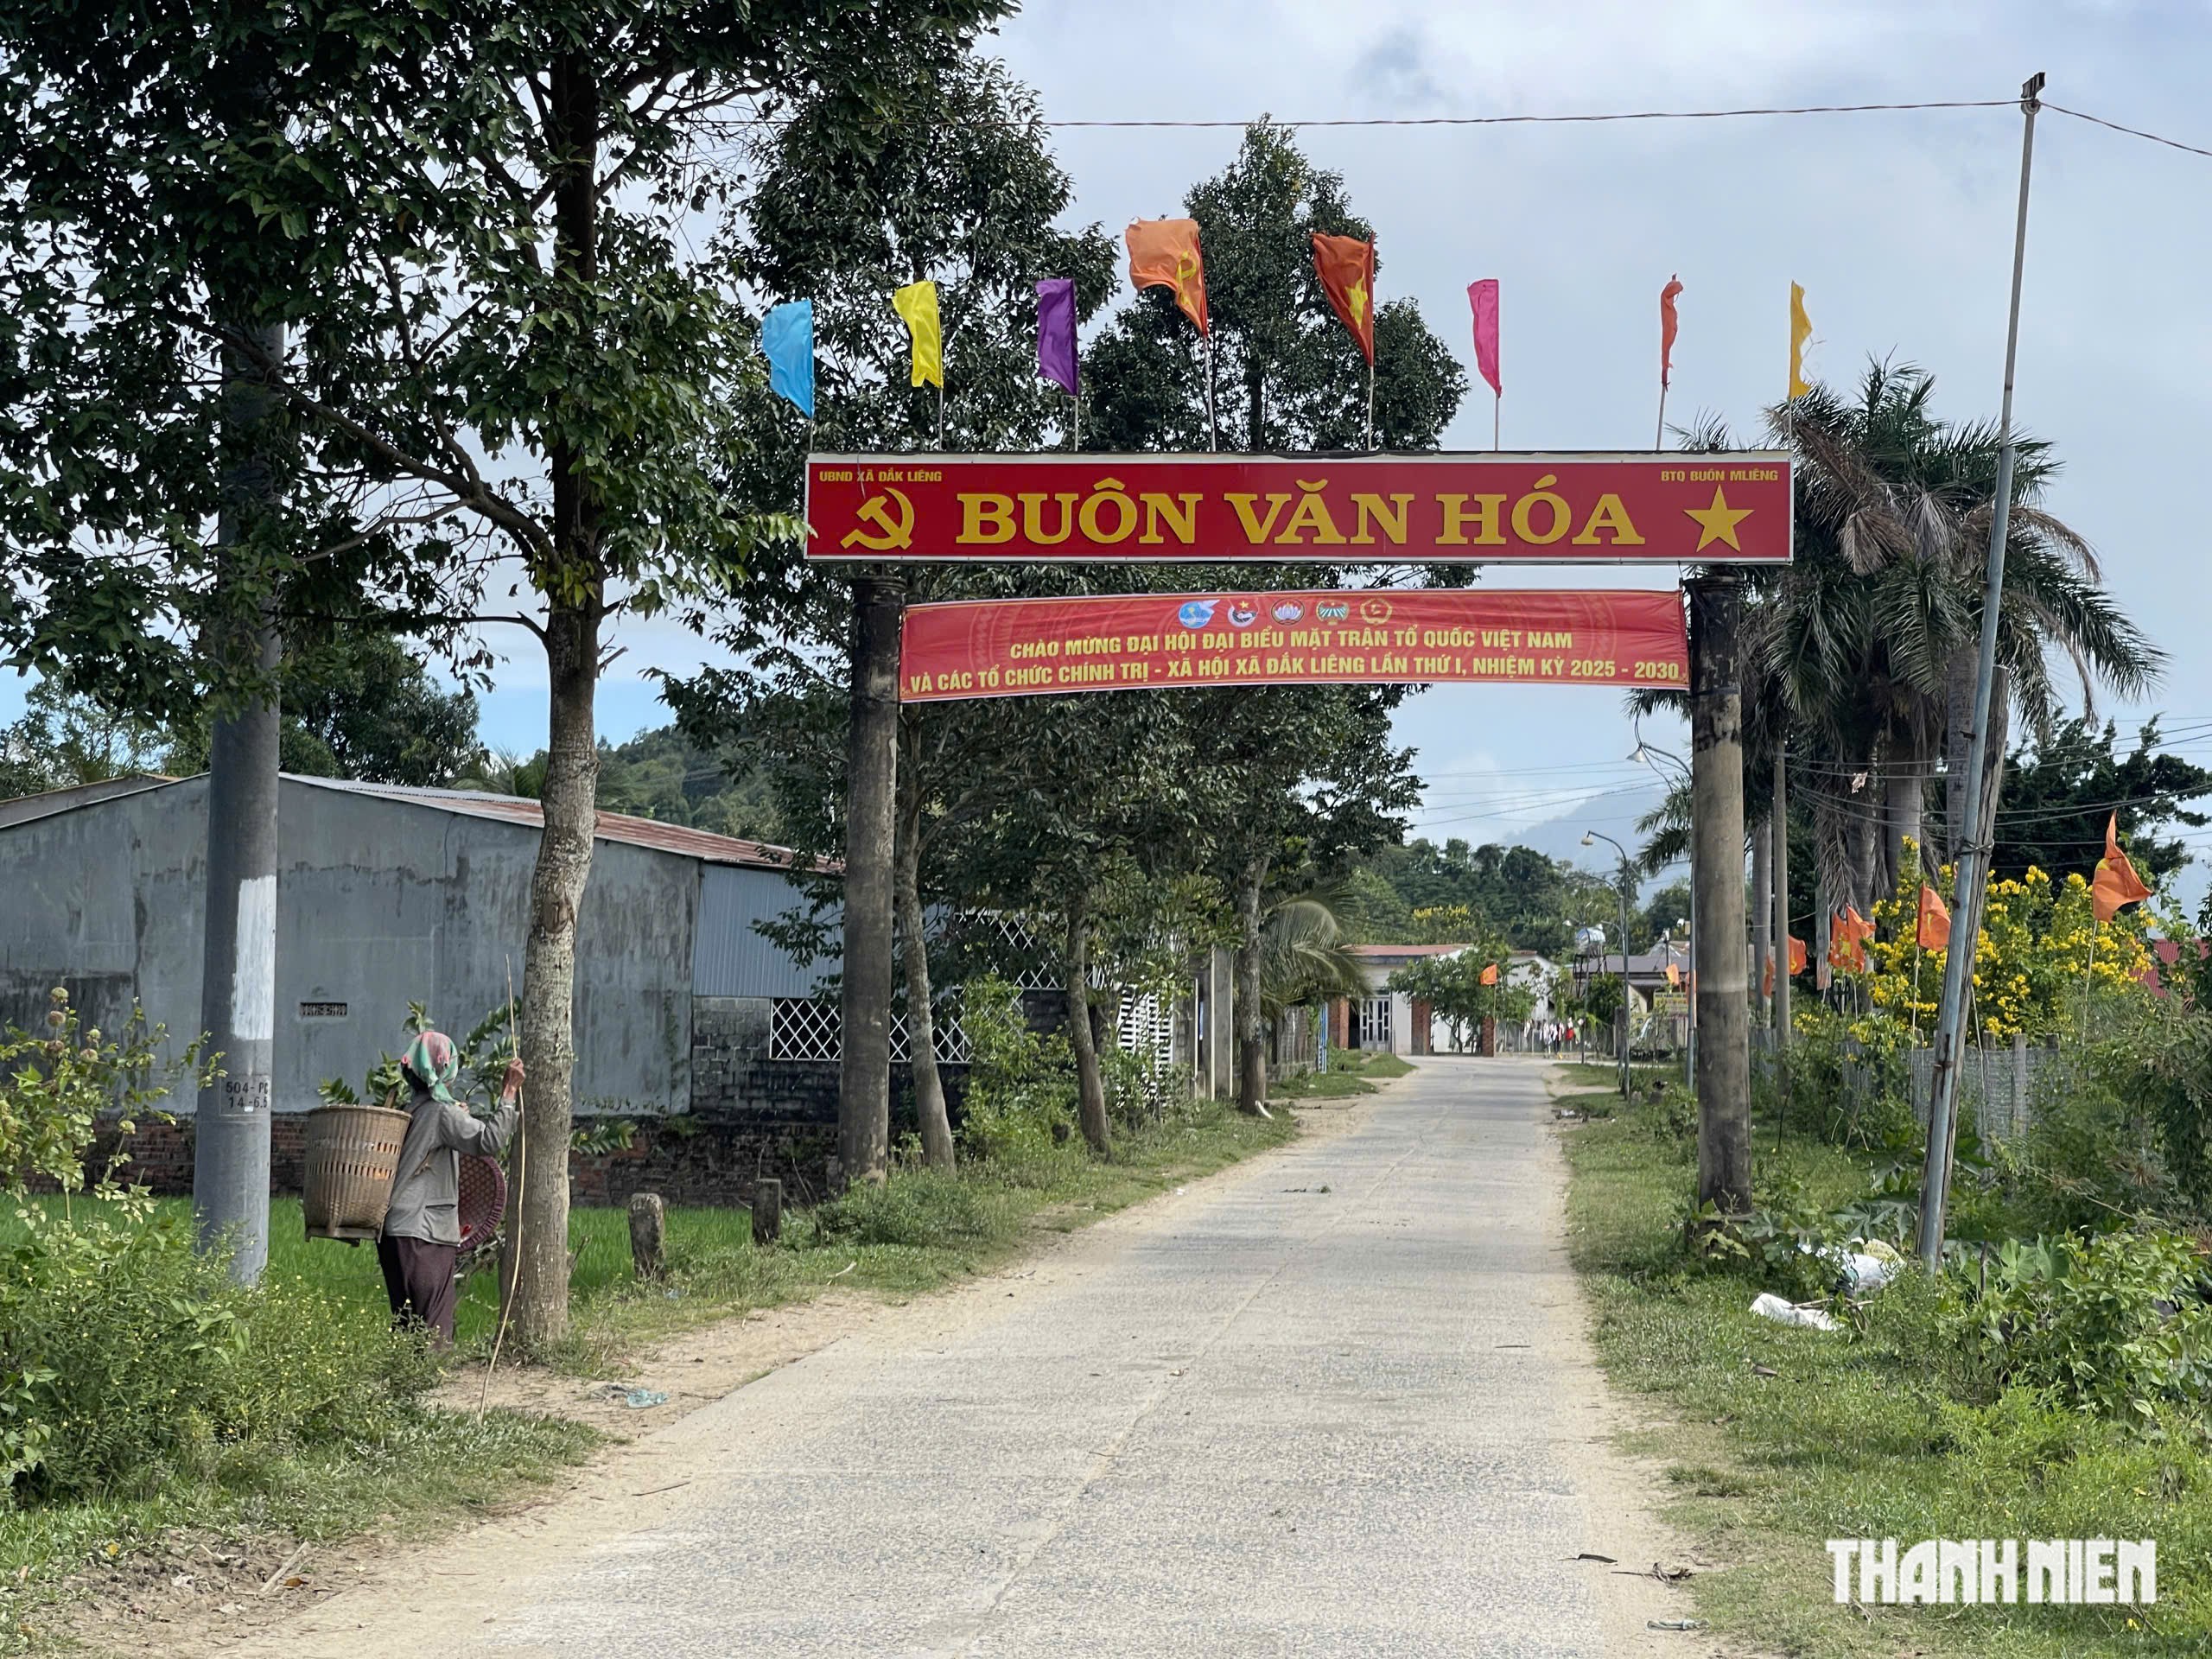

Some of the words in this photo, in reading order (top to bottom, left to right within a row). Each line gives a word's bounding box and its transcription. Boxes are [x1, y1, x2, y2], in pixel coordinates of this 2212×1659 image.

[819, 471, 853, 482] UBND
[856, 468, 874, 482] XÃ
[907, 469, 942, 482] LIÊNG
[1689, 468, 1726, 481] BUÔN
[1729, 468, 1779, 481] MLIÊNG
[956, 477, 1203, 544] BUÔN
[1224, 479, 1415, 545] VĂN
[1435, 474, 1645, 545] HÓA
[1010, 639, 1059, 659] CHÀO
[1065, 635, 1121, 656] MỪNG
[1127, 635, 1159, 655] ĐẠI
[1165, 631, 1197, 654] HỘI
[1202, 633, 1234, 652] ĐẠI
[1241, 626, 1284, 648] BIỂU
[1290, 628, 1332, 651] MẶT
[1338, 627, 1389, 651] TRẬN
[1394, 624, 1418, 647] TỔ
[1424, 626, 1475, 648] QUỐC
[1481, 628, 1520, 651] VIỆT
[1528, 632, 1573, 648] NAM
[911, 671, 932, 692] VÀ
[938, 669, 972, 690] CÁC
[977, 664, 1000, 688] TỔ
[1005, 664, 1053, 686] CHỨC
[1058, 662, 1115, 683] CHÍNH
[1121, 662, 1149, 683] TRỊ
[1168, 657, 1192, 677] XÃ
[1198, 657, 1230, 679] HỘI
[1236, 655, 1261, 675] XÃ
[1266, 652, 1305, 674] ĐẮK
[1311, 654, 1365, 674] LIÊNG
[1414, 654, 1451, 674] THỨ
[1472, 656, 1535, 679] NHIỆM
[1541, 655, 1564, 676] KỲ
[1571, 661, 1616, 677] 2025
[1634, 663, 1679, 680] 2030
